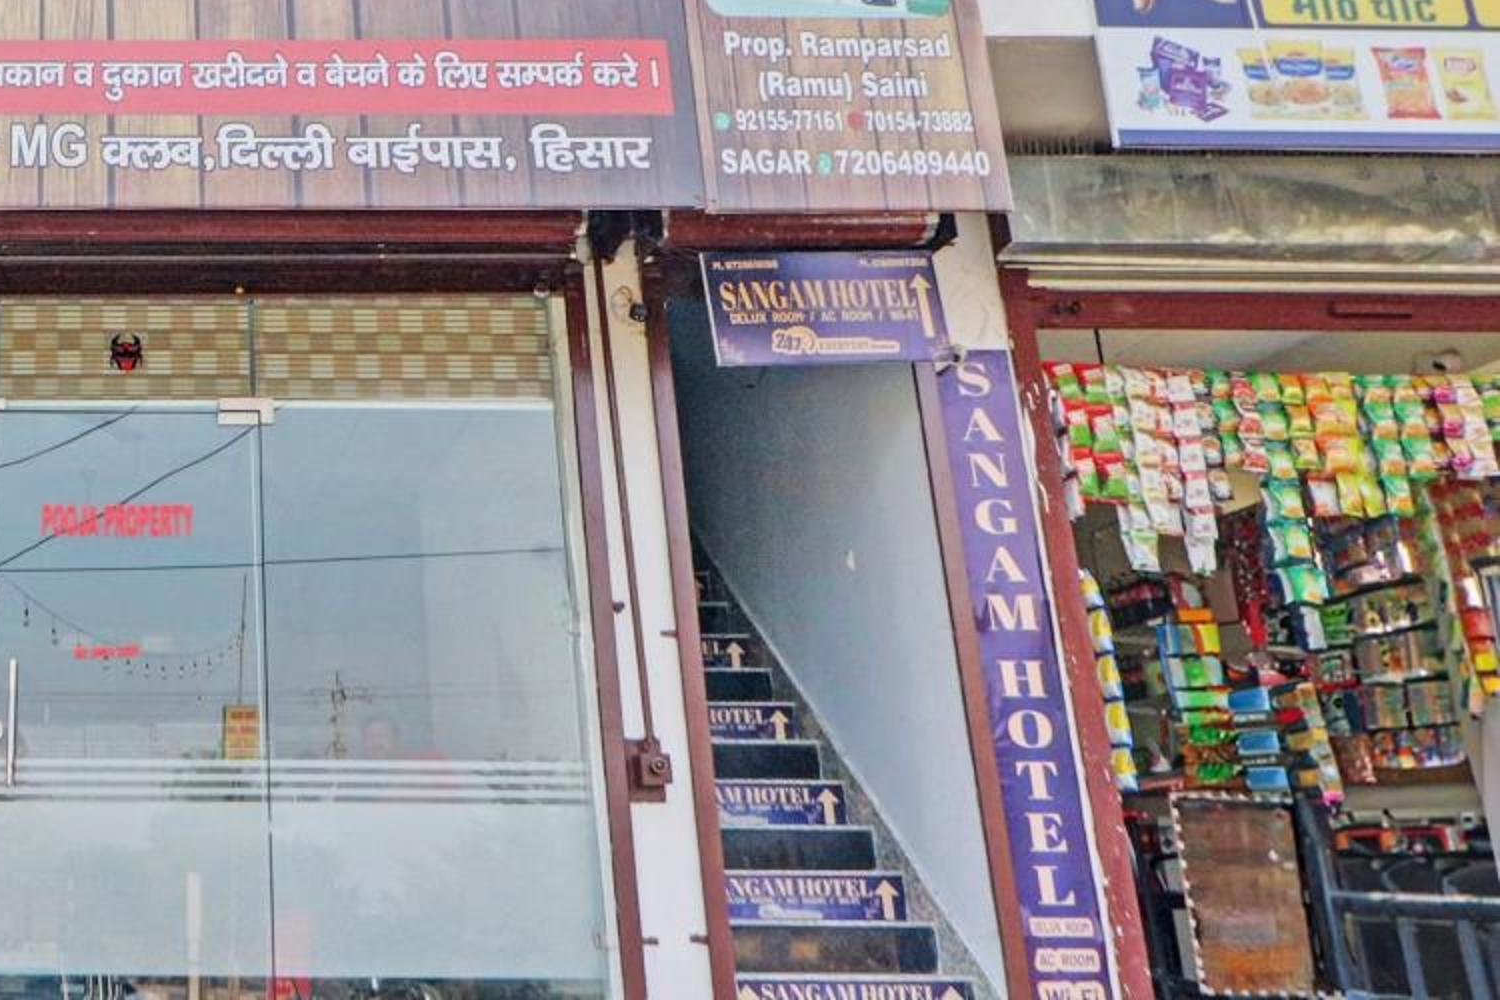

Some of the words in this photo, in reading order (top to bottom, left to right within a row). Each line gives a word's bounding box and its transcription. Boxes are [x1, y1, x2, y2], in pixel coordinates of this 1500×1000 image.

[722, 31, 792, 63] Prop.
[799, 31, 951, 64] Ramparsad
[72, 61, 94, 88] व
[101, 61, 185, 102] दुकान
[189, 51, 289, 89] खरीदने
[295, 61, 317, 88] व
[324, 53, 390, 89] बेचने
[397, 53, 427, 89] के
[434, 50, 488, 89] लिए
[495, 51, 585, 88] सम्पर्क
[591, 52, 639, 88] करे
[758, 71, 853, 103] (Ramu)
[860, 70, 928, 97] Saini
[734, 108, 844, 132] 92155-77161
[864, 110, 975, 133] 70154-73882
[9, 121, 89, 168] MG
[346, 121, 517, 174] बाईपास,
[528, 121, 653, 170] हिसार
[720, 148, 813, 175] SAGAR
[835, 150, 991, 177] 7206489440
[719, 278, 829, 312] SANGAM
[830, 278, 917, 309] HOTEL
[956, 363, 1039, 632] SANGAM
[41, 503, 100, 537] POOJA
[103, 503, 195, 537] PROPERTY
[746, 786, 816, 804] HOTEL
[996, 659, 1077, 907] HOTEL
[799, 877, 874, 899] HOTEL
